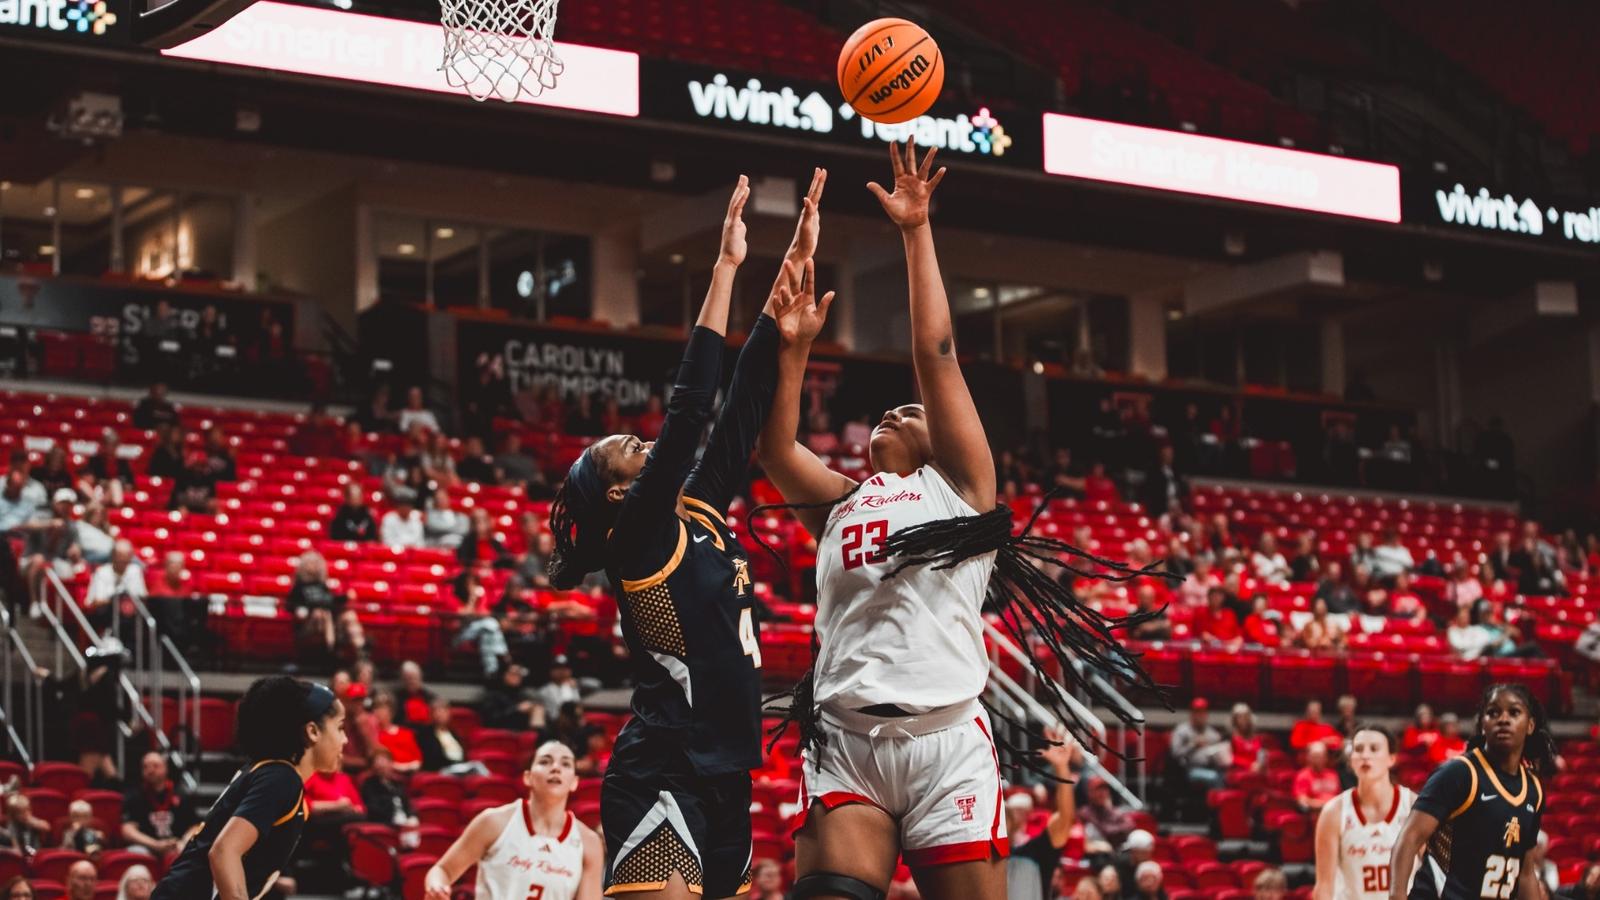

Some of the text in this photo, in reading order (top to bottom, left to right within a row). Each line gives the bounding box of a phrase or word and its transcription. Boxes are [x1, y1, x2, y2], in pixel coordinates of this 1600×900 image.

[224, 14, 392, 68] Smarter
[869, 55, 930, 104] Wilson
[1090, 129, 1318, 198] Smarter Home
[505, 339, 624, 375] CAROLYN
[861, 490, 922, 508] Raiders
[842, 520, 888, 571] 23
[739, 608, 762, 668] 4
[1363, 865, 1391, 893] 20
[1480, 854, 1520, 900] 23
